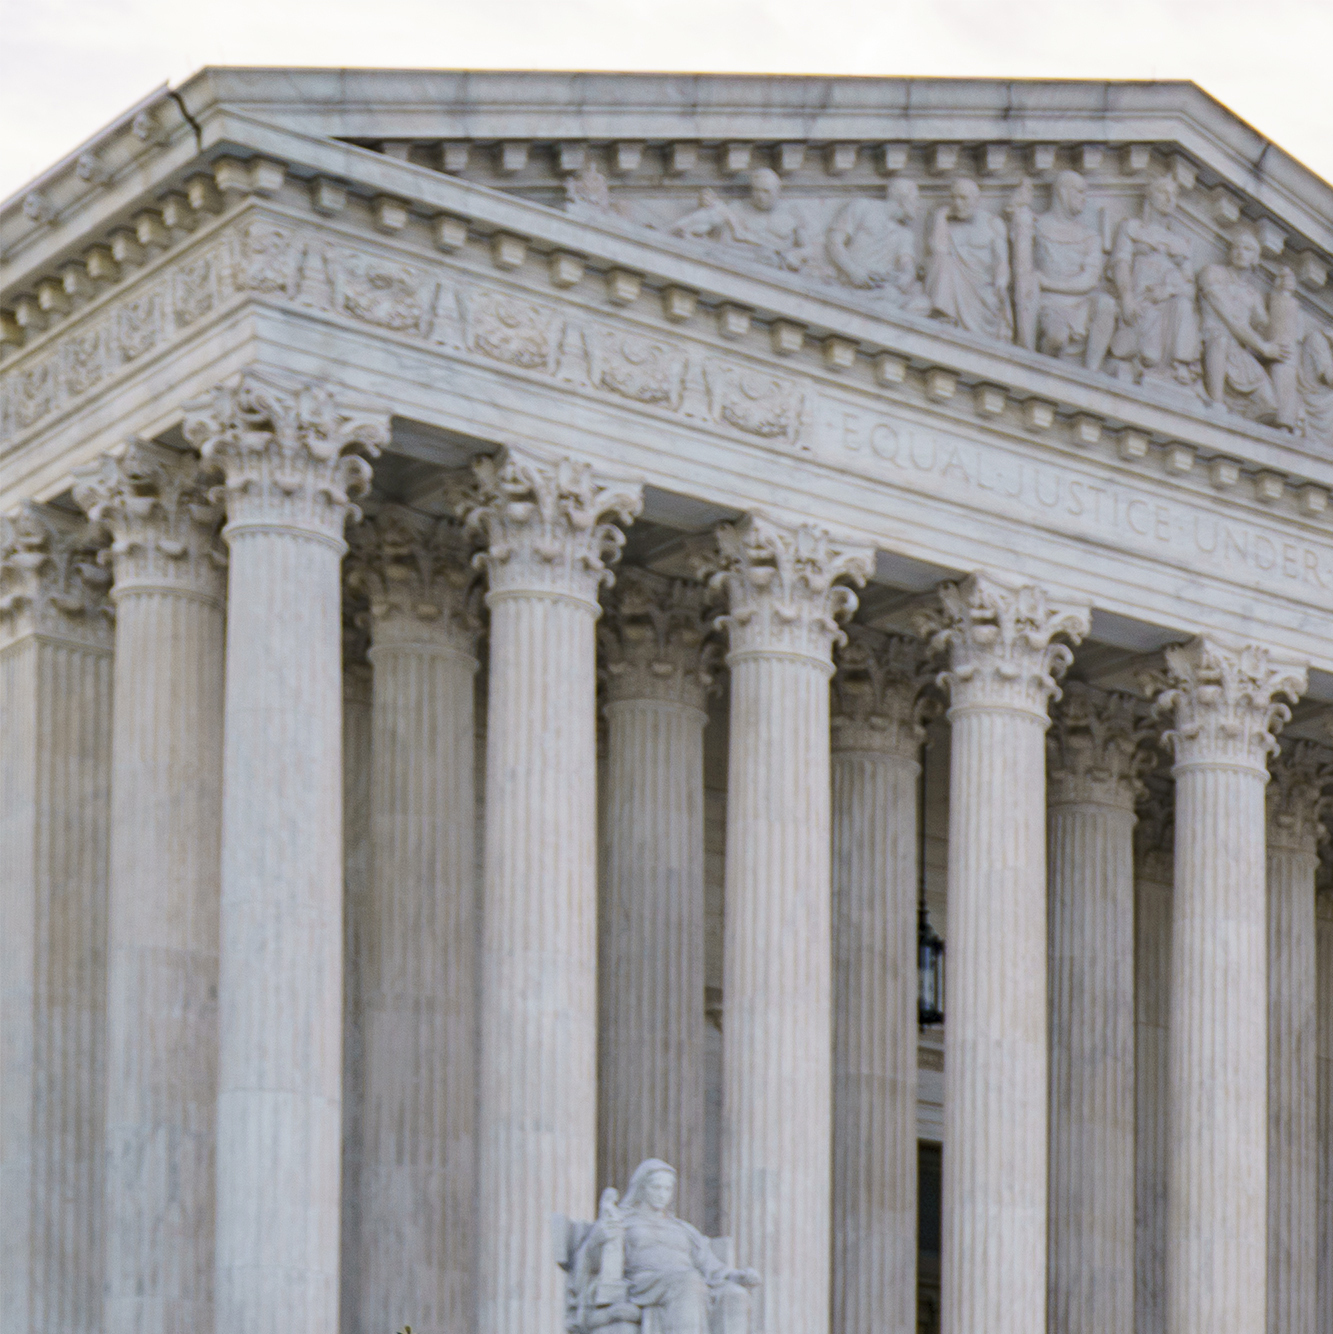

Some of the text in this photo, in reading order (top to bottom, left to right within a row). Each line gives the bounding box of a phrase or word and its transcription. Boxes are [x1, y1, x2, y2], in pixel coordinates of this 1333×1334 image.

[842, 411, 995, 490] EQUAL
[1004, 463, 1170, 542] JUSTICE
[1192, 514, 1330, 590] UNDER
